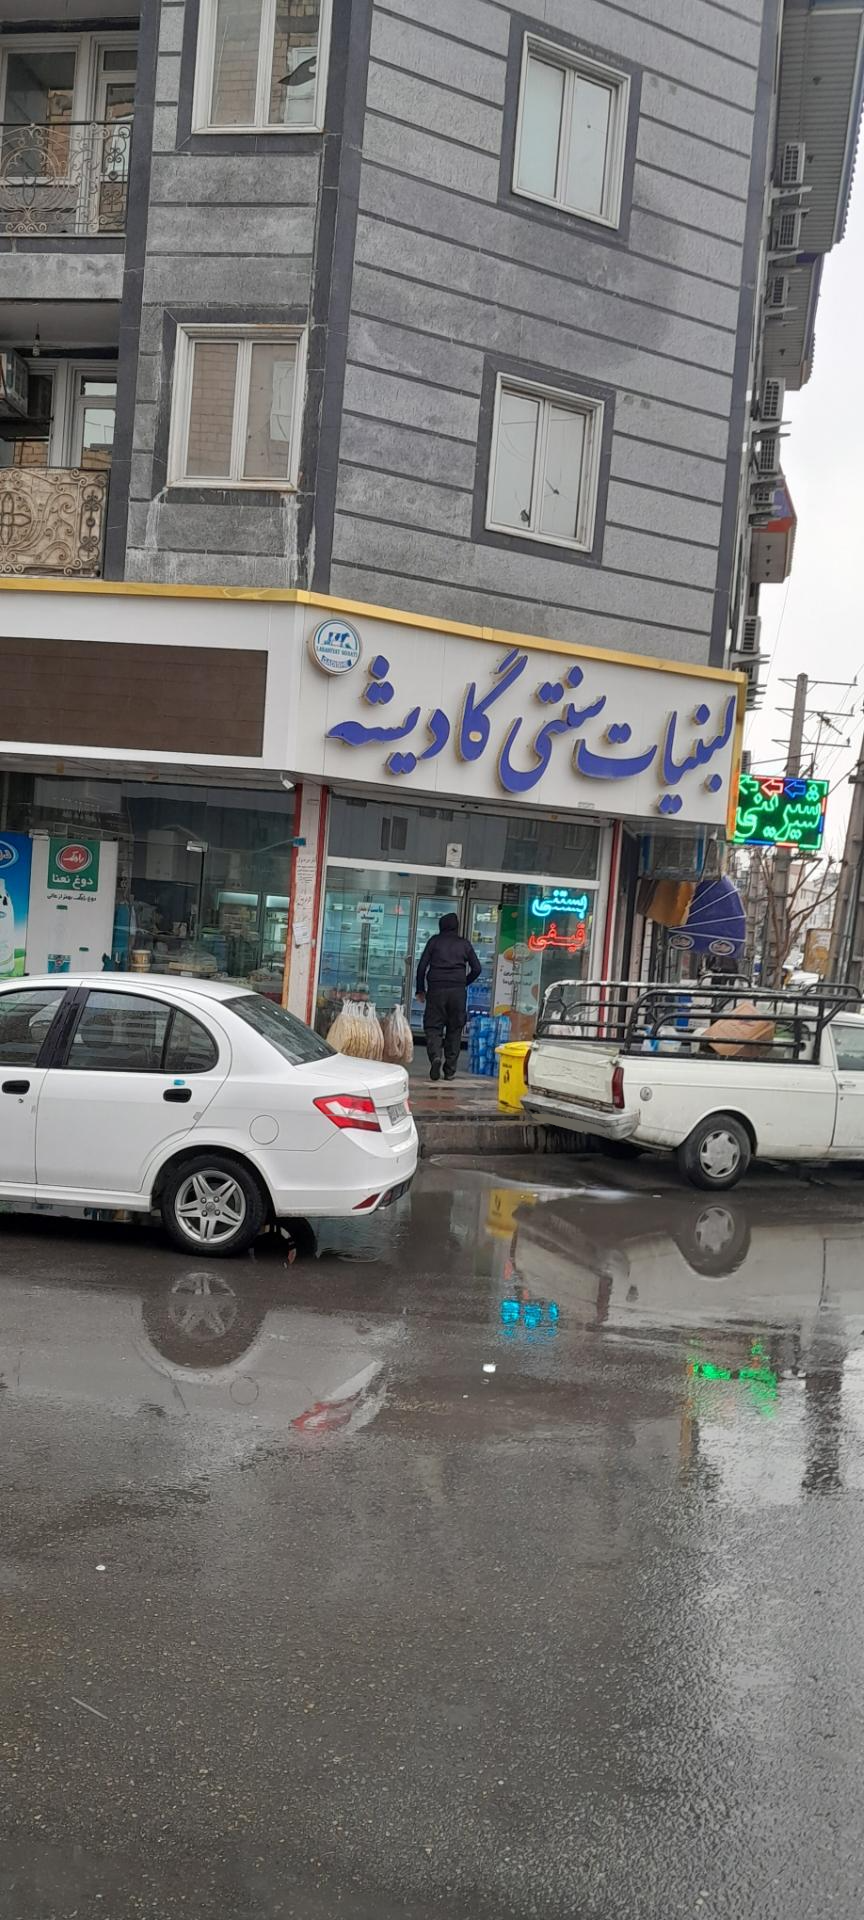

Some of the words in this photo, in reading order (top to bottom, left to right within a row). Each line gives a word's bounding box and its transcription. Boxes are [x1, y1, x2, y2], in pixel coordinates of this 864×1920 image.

[325, 648, 528, 775] گادیشه
[498, 665, 607, 794] سنتی
[573, 695, 737, 815] لبنیات
[735, 783, 822, 841] شیرینی
[52, 873, 71, 884] نعنا
[72, 875, 93, 890] دوغ
[532, 889, 587, 919] بستنی
[528, 923, 586, 952] قیفی
